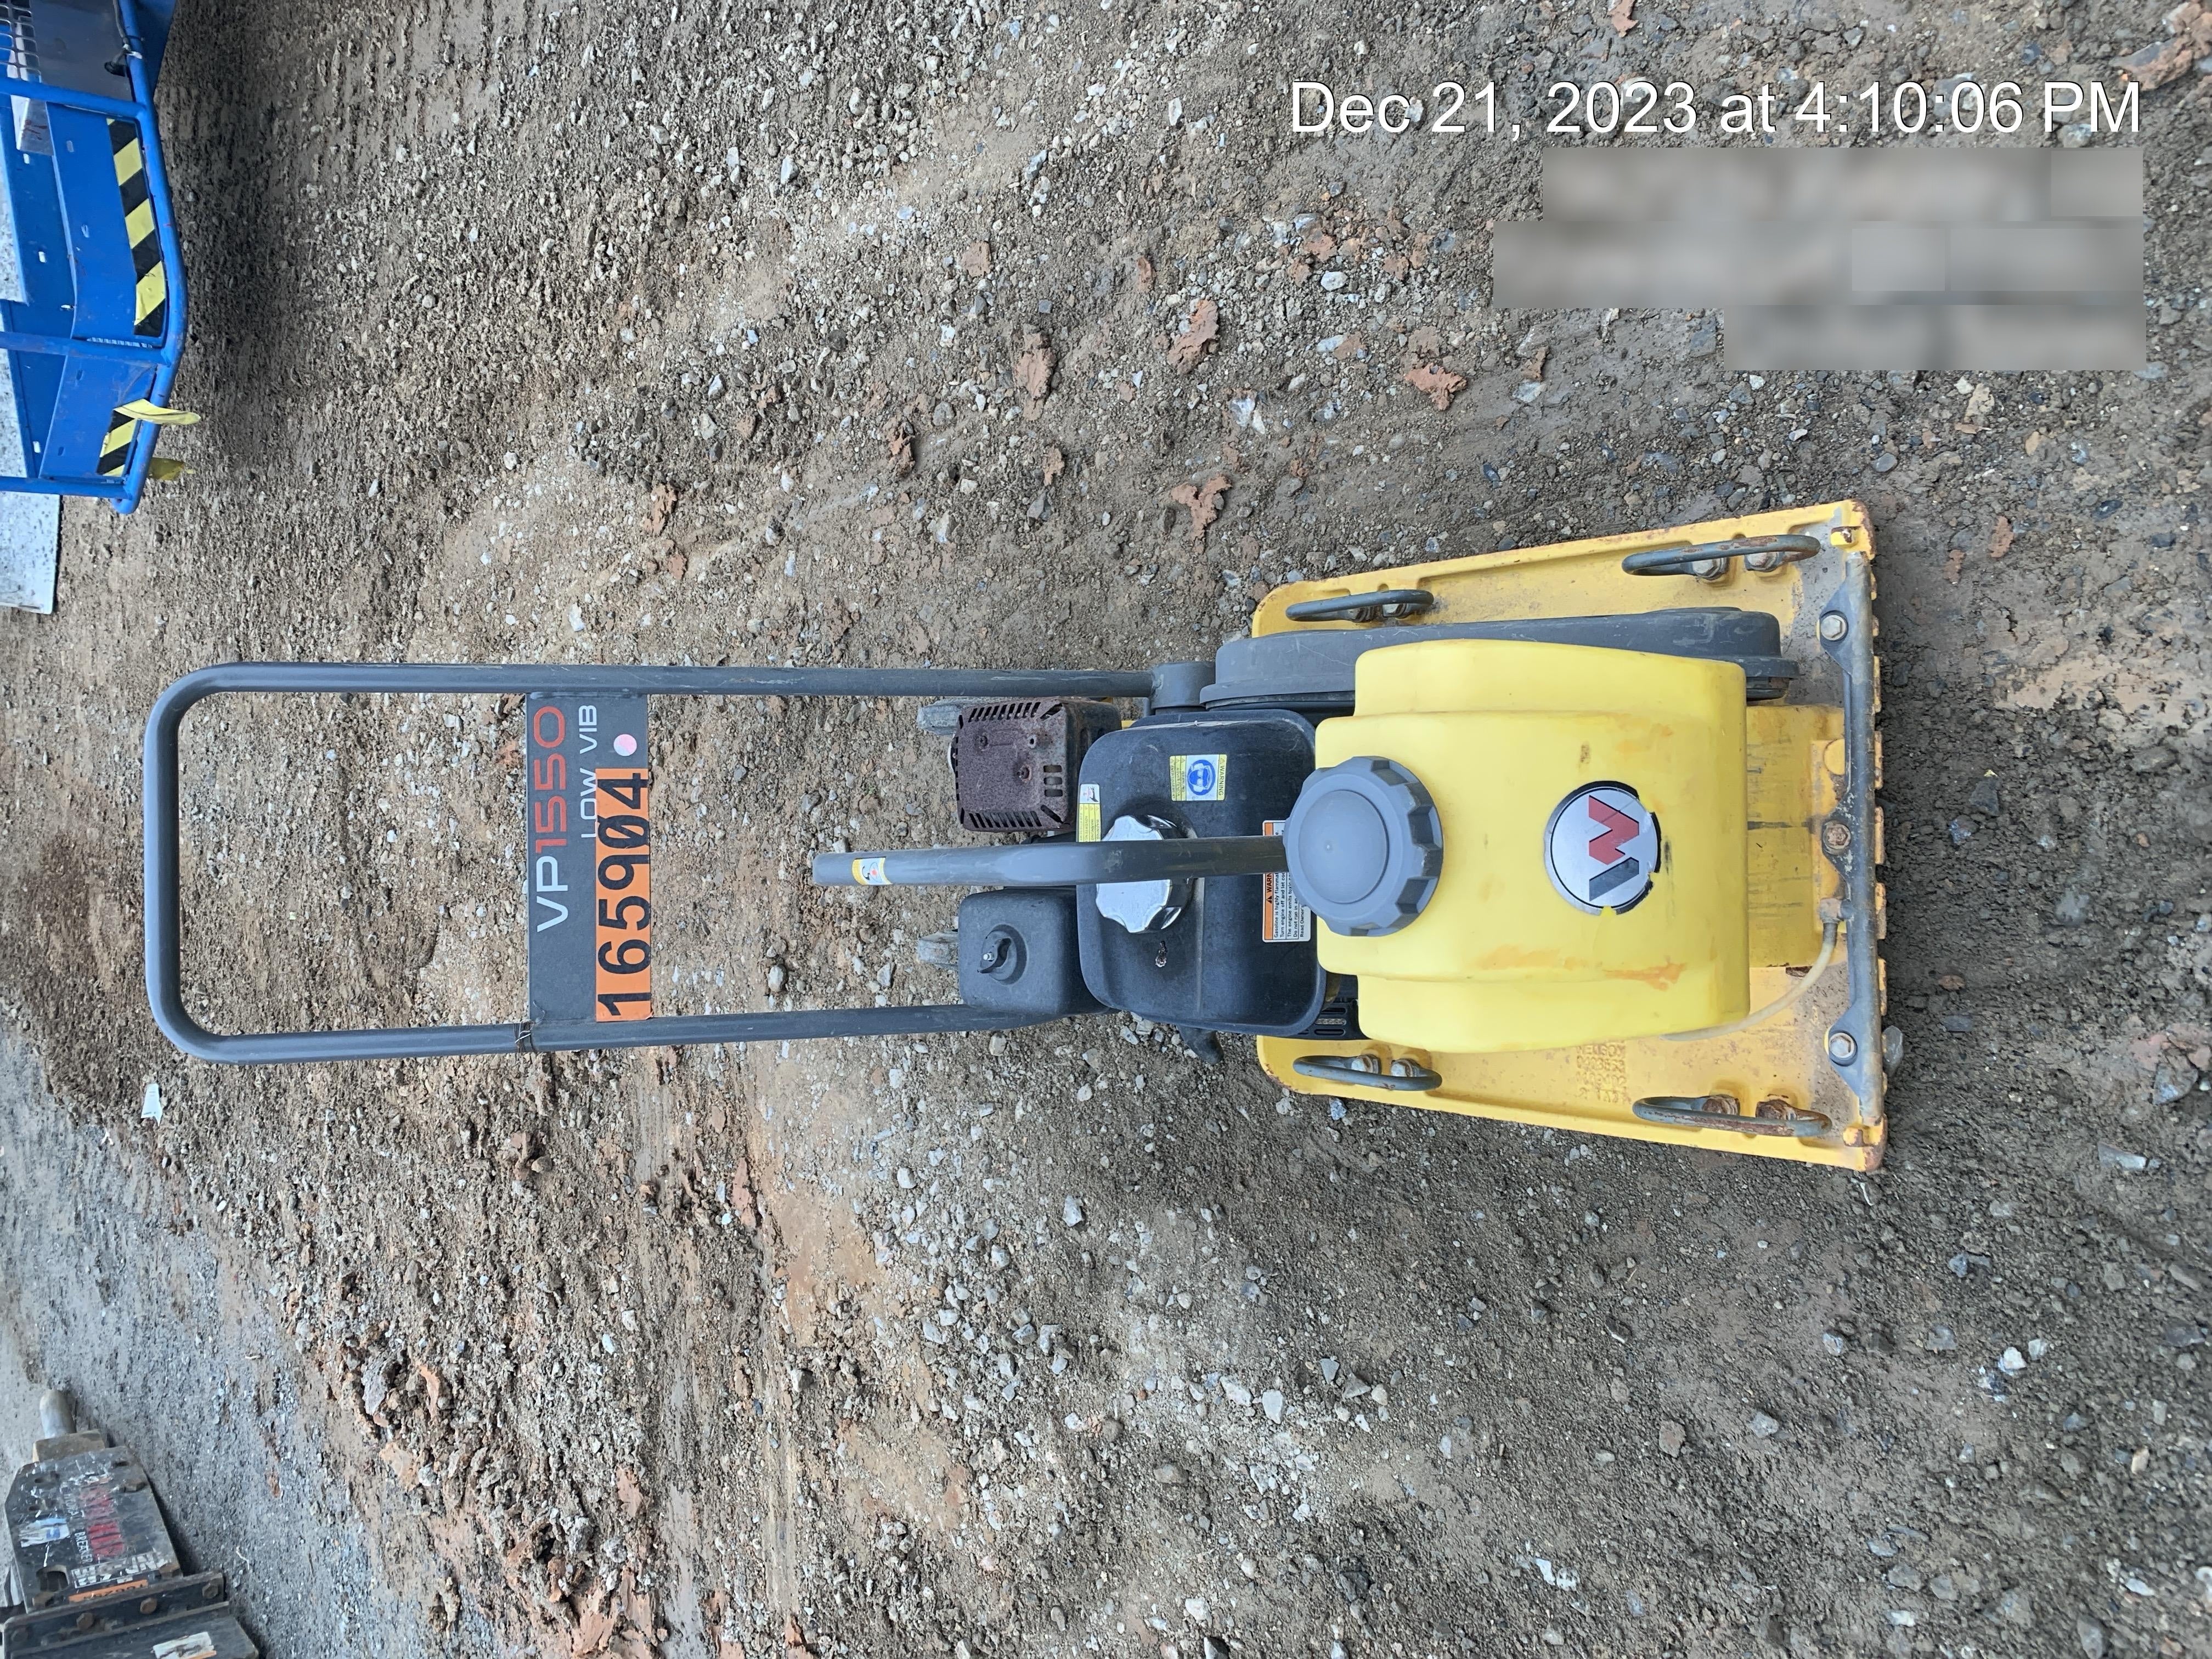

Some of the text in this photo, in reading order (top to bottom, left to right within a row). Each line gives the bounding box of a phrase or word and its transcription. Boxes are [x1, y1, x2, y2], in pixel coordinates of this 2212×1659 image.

[533, 705, 568, 933] VP1550
[578, 705, 598, 838] LOW VIB
[596, 772, 651, 1017] 165904
